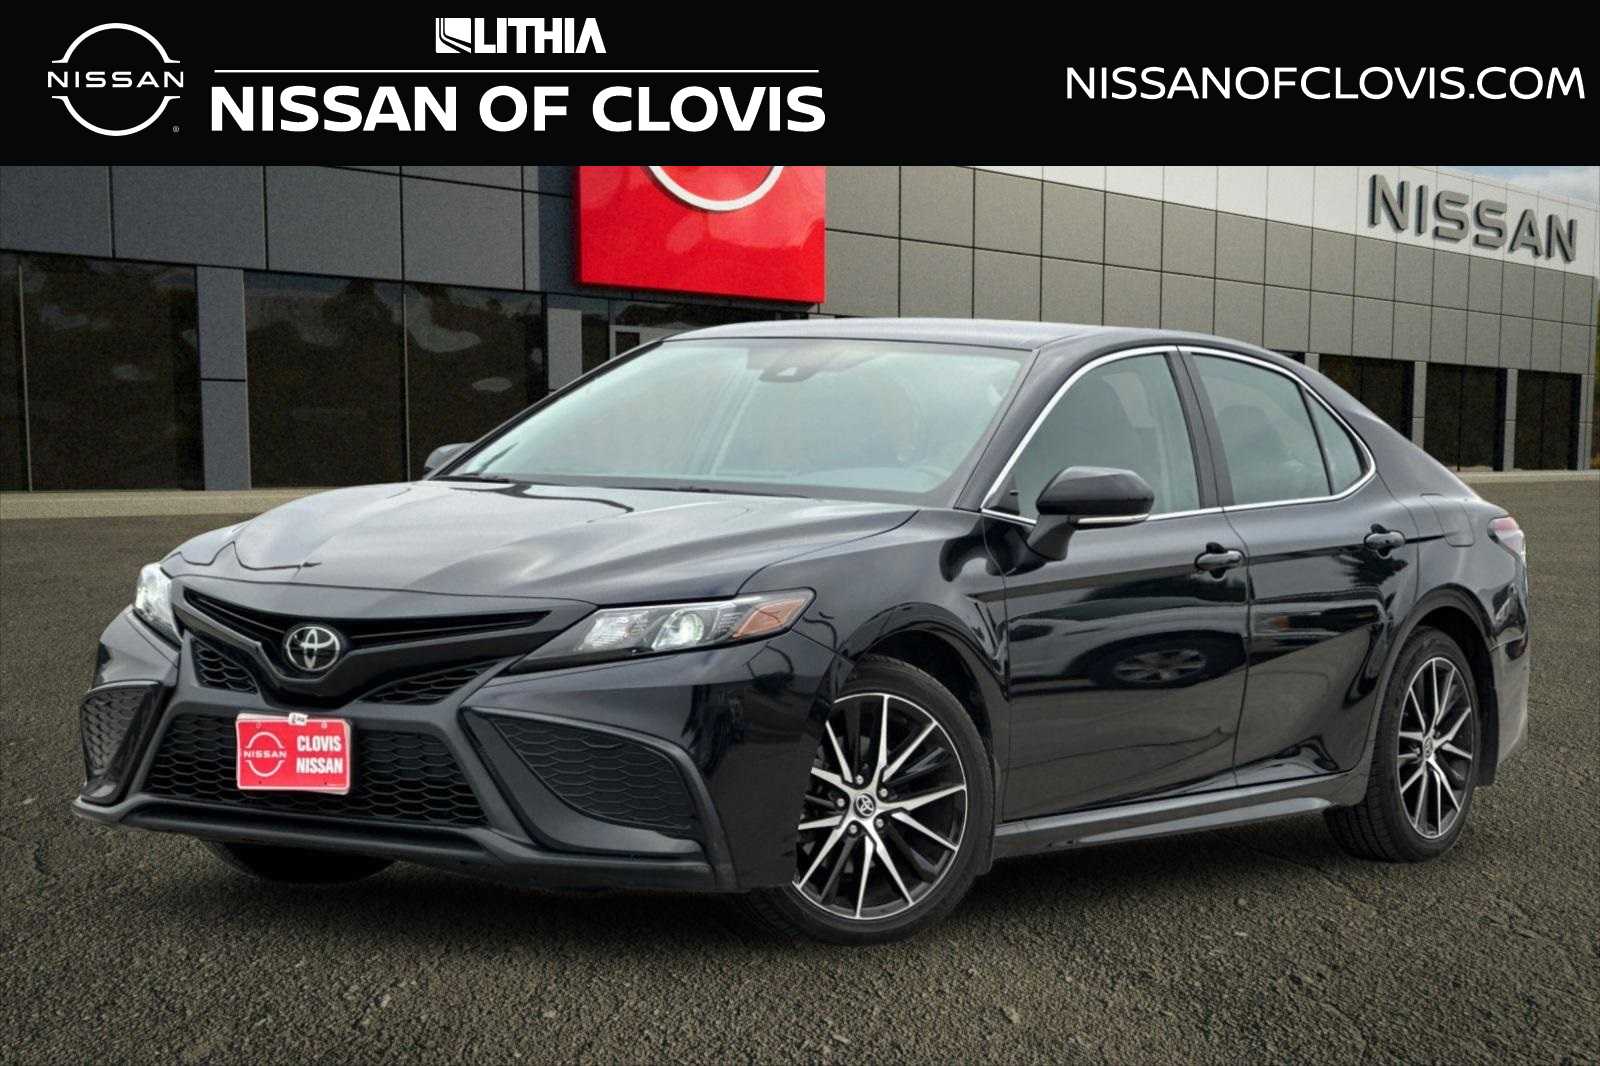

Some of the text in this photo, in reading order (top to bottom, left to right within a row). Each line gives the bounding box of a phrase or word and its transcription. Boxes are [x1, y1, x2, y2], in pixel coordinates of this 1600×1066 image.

[1368, 173, 1578, 263] NISSAN
[296, 735, 342, 752] CLOVIS
[243, 750, 287, 759] NISSAN
[296, 757, 343, 774] NISSAN
